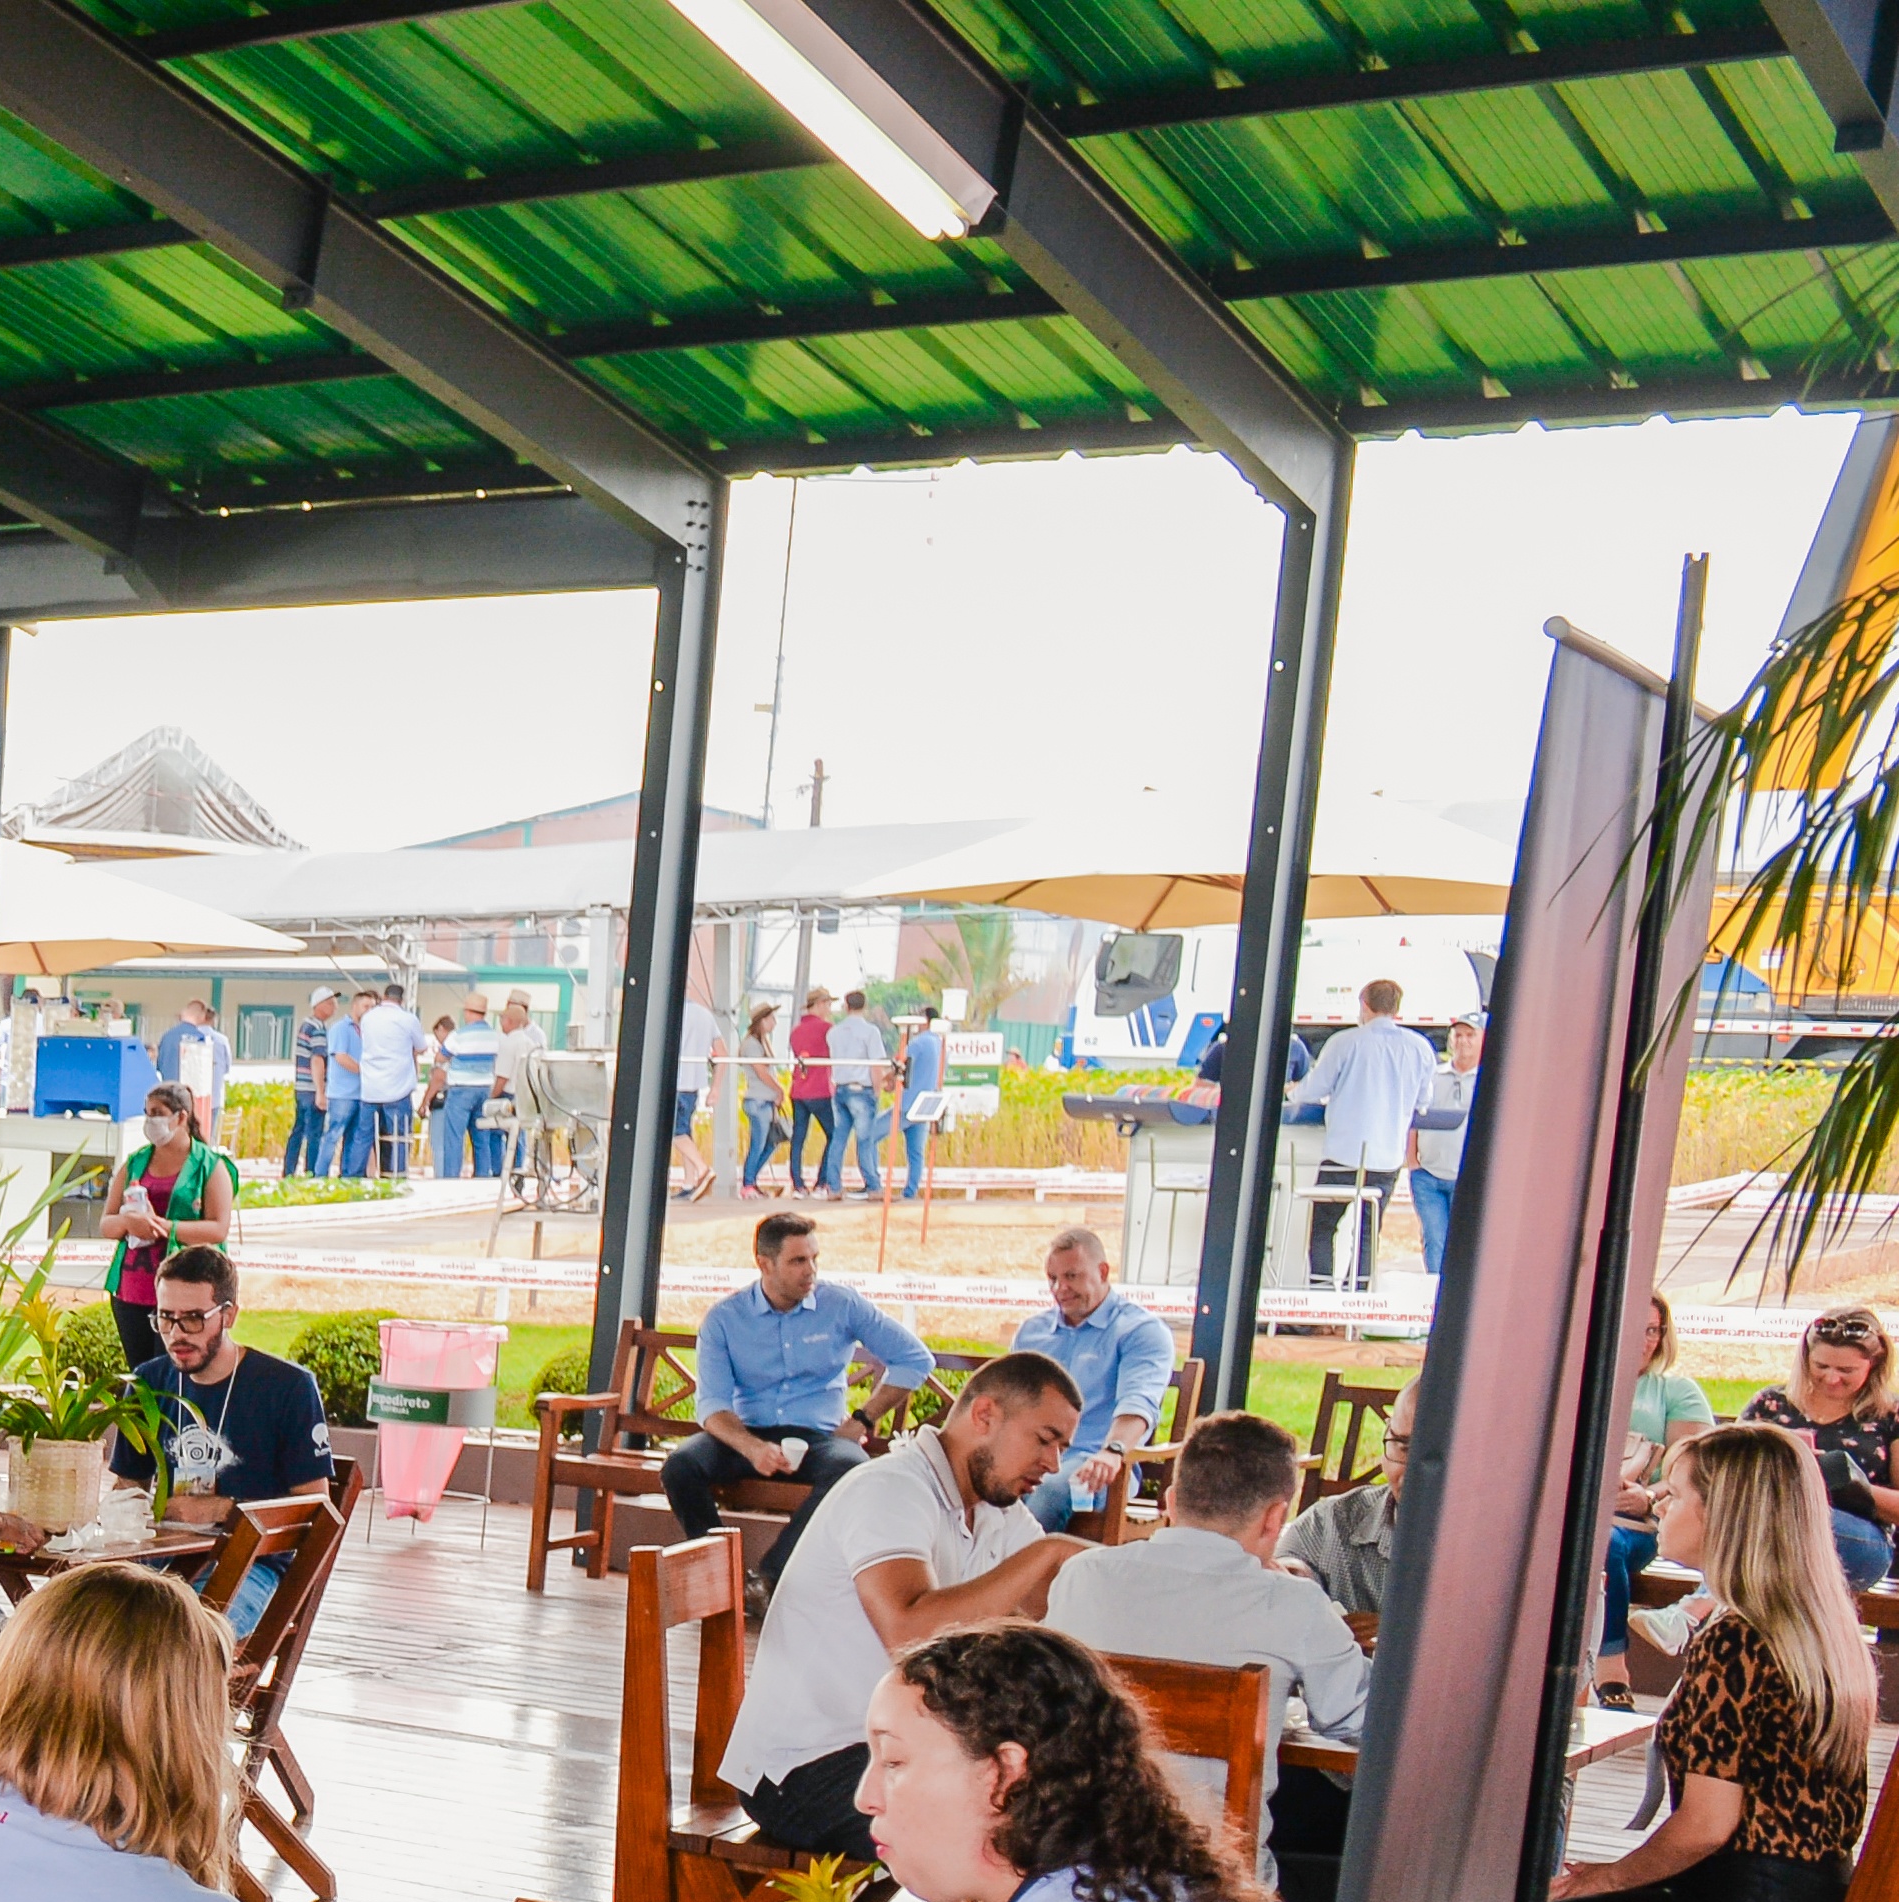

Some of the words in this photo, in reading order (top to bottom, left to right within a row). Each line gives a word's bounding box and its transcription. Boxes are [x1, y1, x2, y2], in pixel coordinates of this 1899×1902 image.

[896, 1281, 936, 1291] cotrijal
[966, 1285, 1007, 1295] cotrijal
[1263, 1296, 1309, 1307] cotrijal
[1341, 1299, 1388, 1310] cotrijal
[1674, 1314, 1724, 1324] cotrijal
